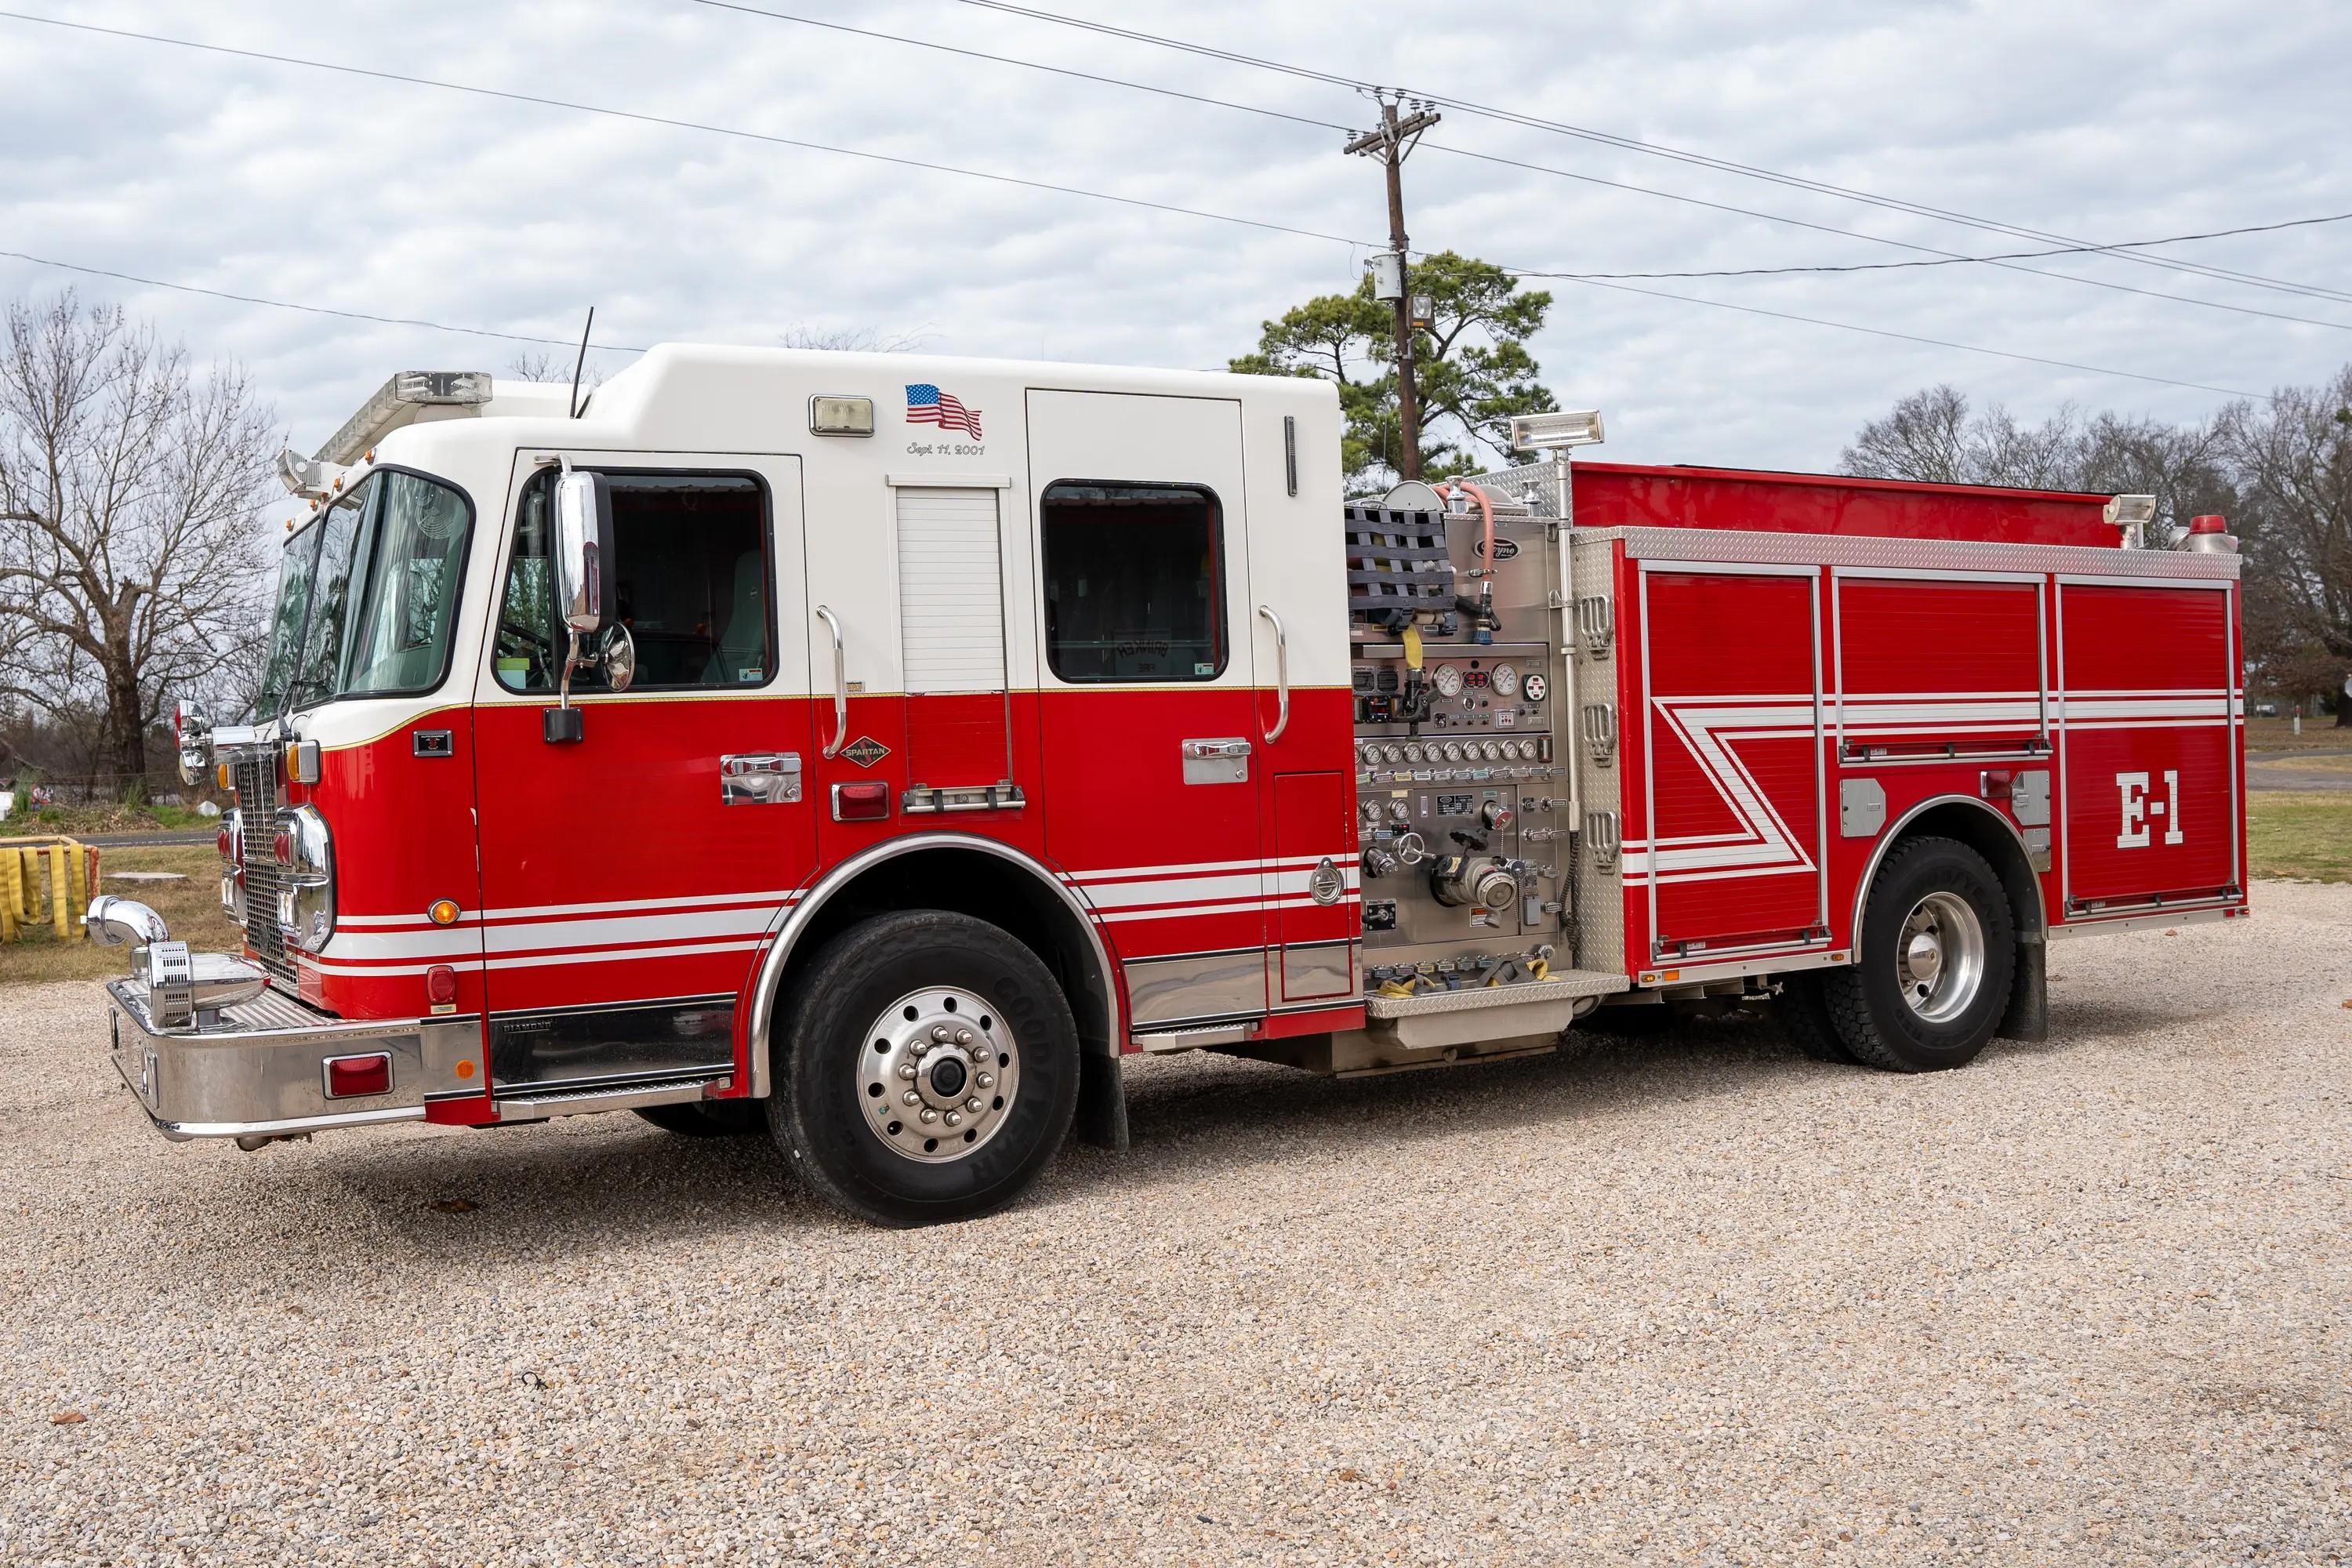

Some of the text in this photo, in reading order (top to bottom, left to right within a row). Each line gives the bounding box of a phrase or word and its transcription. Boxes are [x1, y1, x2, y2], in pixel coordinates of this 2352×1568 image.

[906, 441, 933, 457] Sept
[954, 444, 985, 456] 2001
[846, 748, 885, 757] SPARTAN
[2116, 770, 2183, 848] E-1
[503, 1022, 552, 1033] DIAMOND
